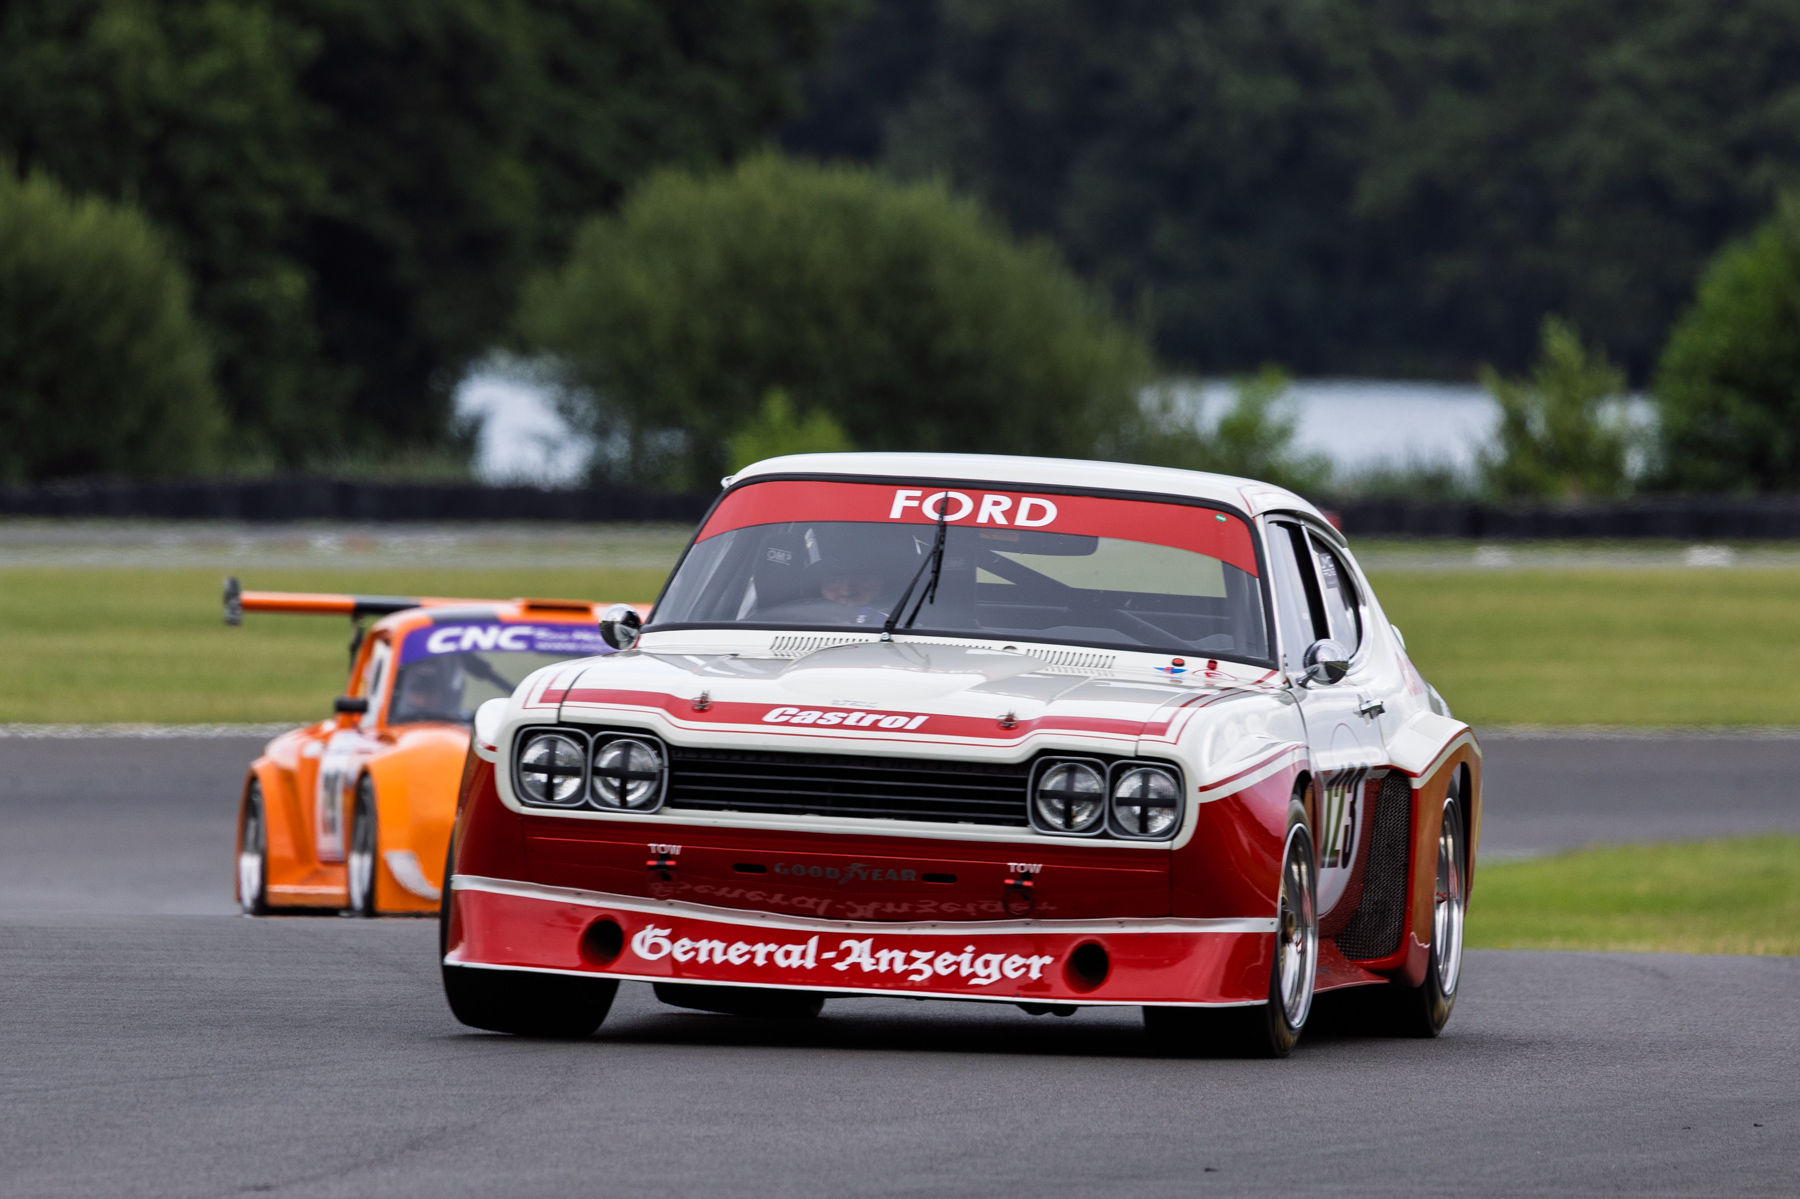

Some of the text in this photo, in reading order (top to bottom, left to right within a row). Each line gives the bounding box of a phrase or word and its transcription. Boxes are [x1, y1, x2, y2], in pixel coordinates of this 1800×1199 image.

[889, 489, 1058, 527] FORD
[426, 625, 535, 653] CNC
[762, 706, 930, 730] Castrol
[647, 843, 682, 856] TOW
[774, 862, 919, 884] GOODYEAR
[1006, 862, 1043, 874] TOW
[631, 924, 1053, 985] General-Anzeiger
